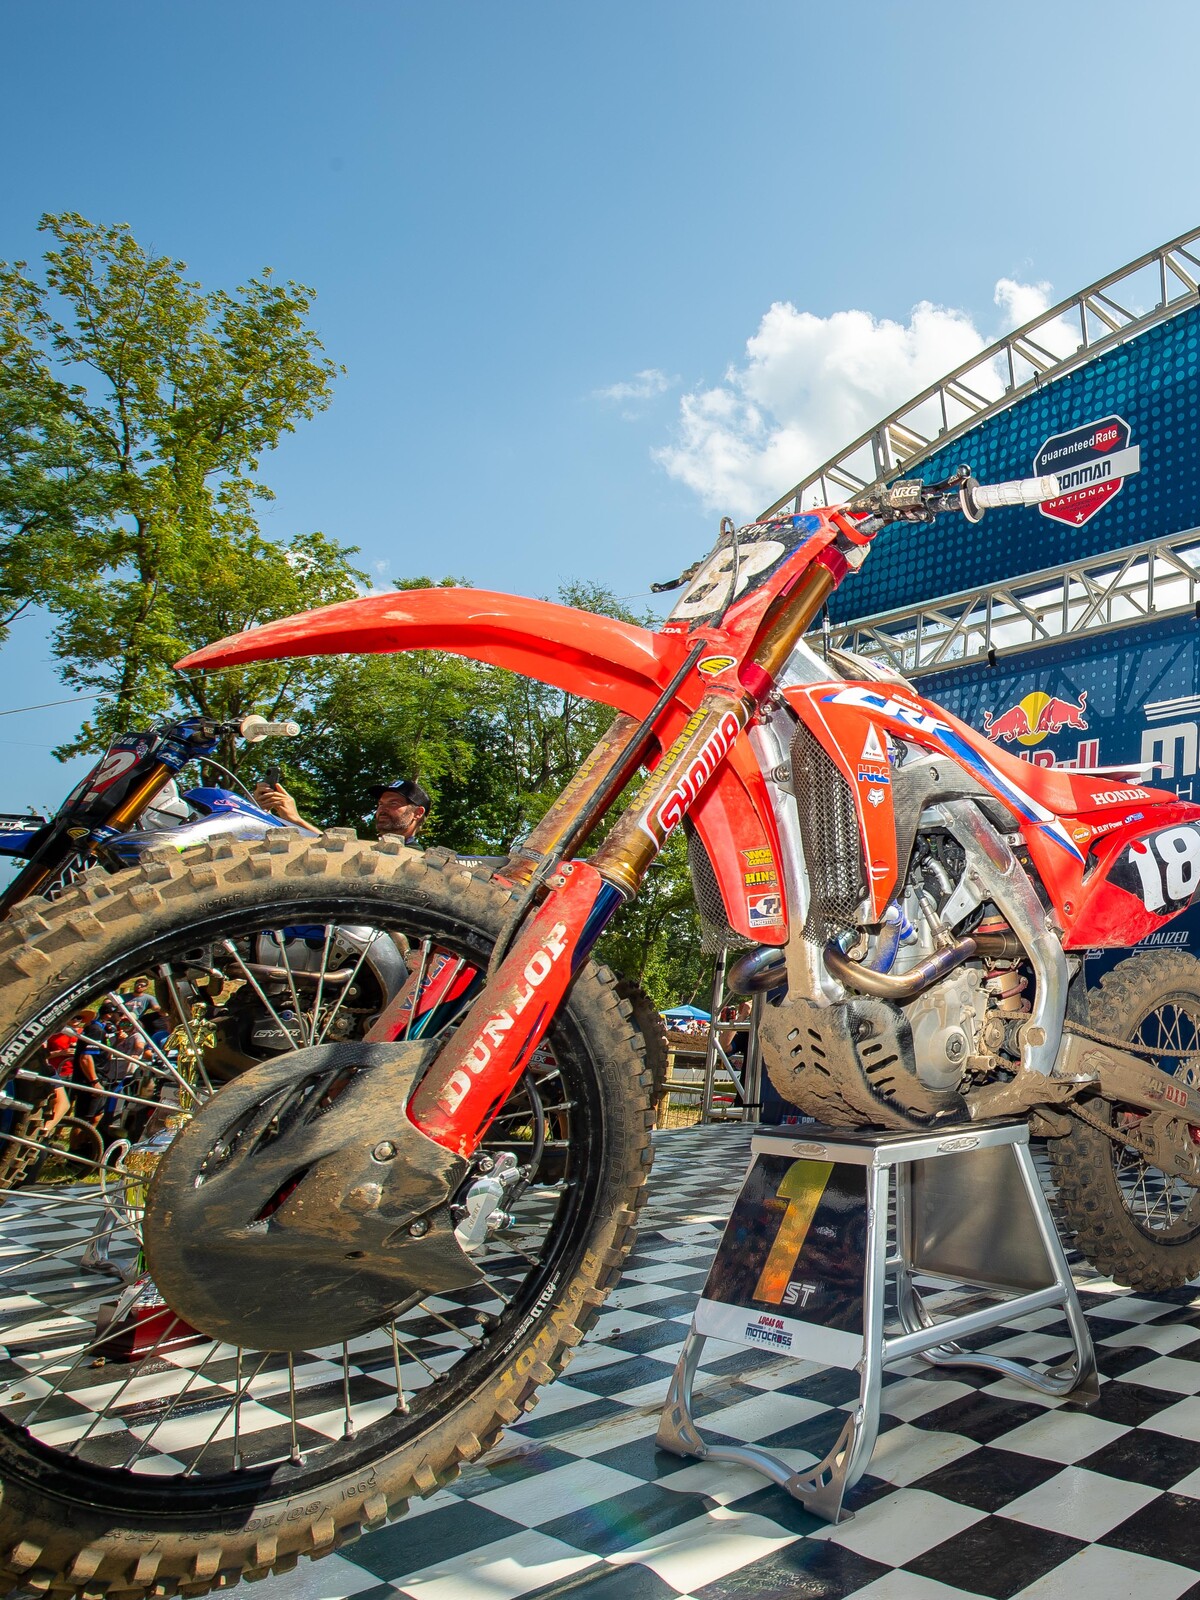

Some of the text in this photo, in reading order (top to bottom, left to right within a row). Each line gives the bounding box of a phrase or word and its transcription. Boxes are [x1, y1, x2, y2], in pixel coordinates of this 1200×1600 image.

[1049, 484, 1113, 508] NATIONAL
[830, 686, 954, 734] CRF
[658, 711, 739, 832] SHOWA
[858, 763, 890, 784] HRC
[1090, 788, 1150, 805] HONDA
[437, 921, 567, 1114] DUNLOP
[753, 1160, 834, 1304] 1
[783, 1281, 816, 1307] ST
[758, 1315, 785, 1330] LUCAS OIL
[745, 1326, 793, 1347] MOTOCROSS
